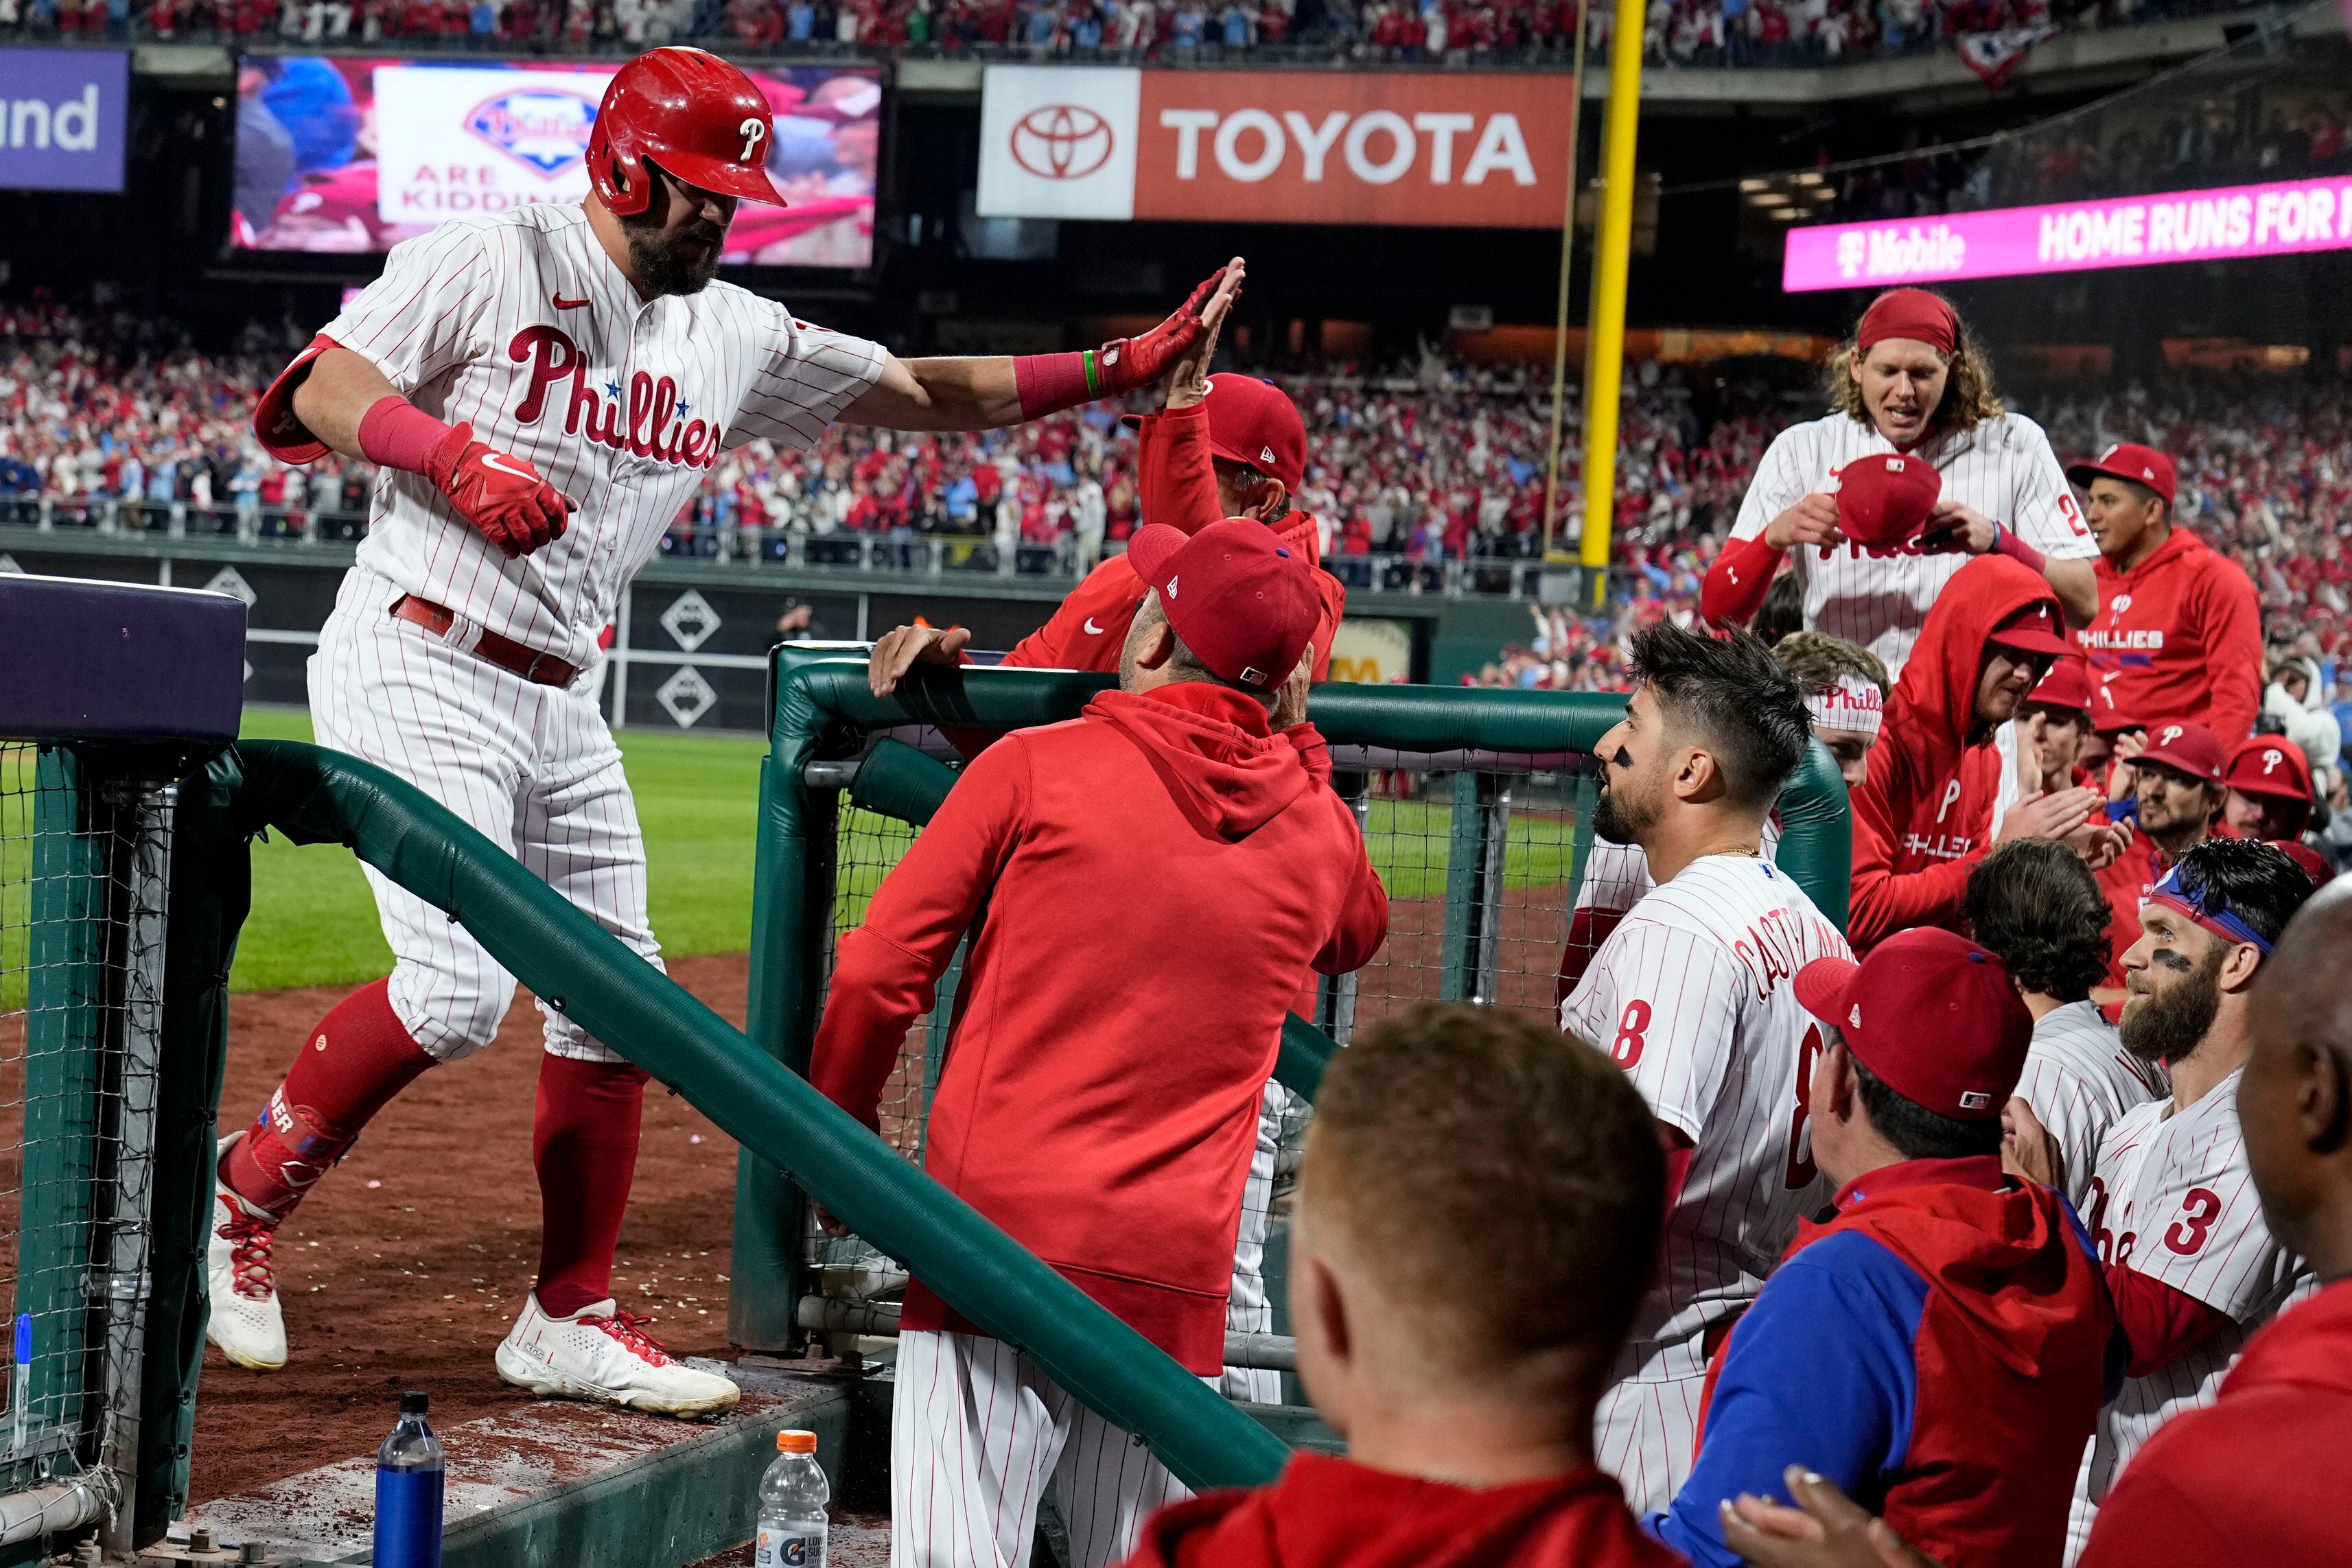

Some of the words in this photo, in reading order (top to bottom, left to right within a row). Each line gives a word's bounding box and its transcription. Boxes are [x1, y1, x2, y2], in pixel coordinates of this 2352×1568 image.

[415, 164, 493, 184] ARE
[740, 118, 765, 161] P
[1161, 108, 1537, 185] TOYOTA
[2038, 205, 2145, 264] HOME
[2148, 194, 2251, 253] RUNS
[2255, 187, 2333, 245] FOR
[508, 324, 721, 470] Phillies
[2058, 494, 2088, 537] 2
[1609, 999, 1652, 1071] 8
[2164, 1188, 2222, 1256] 3
